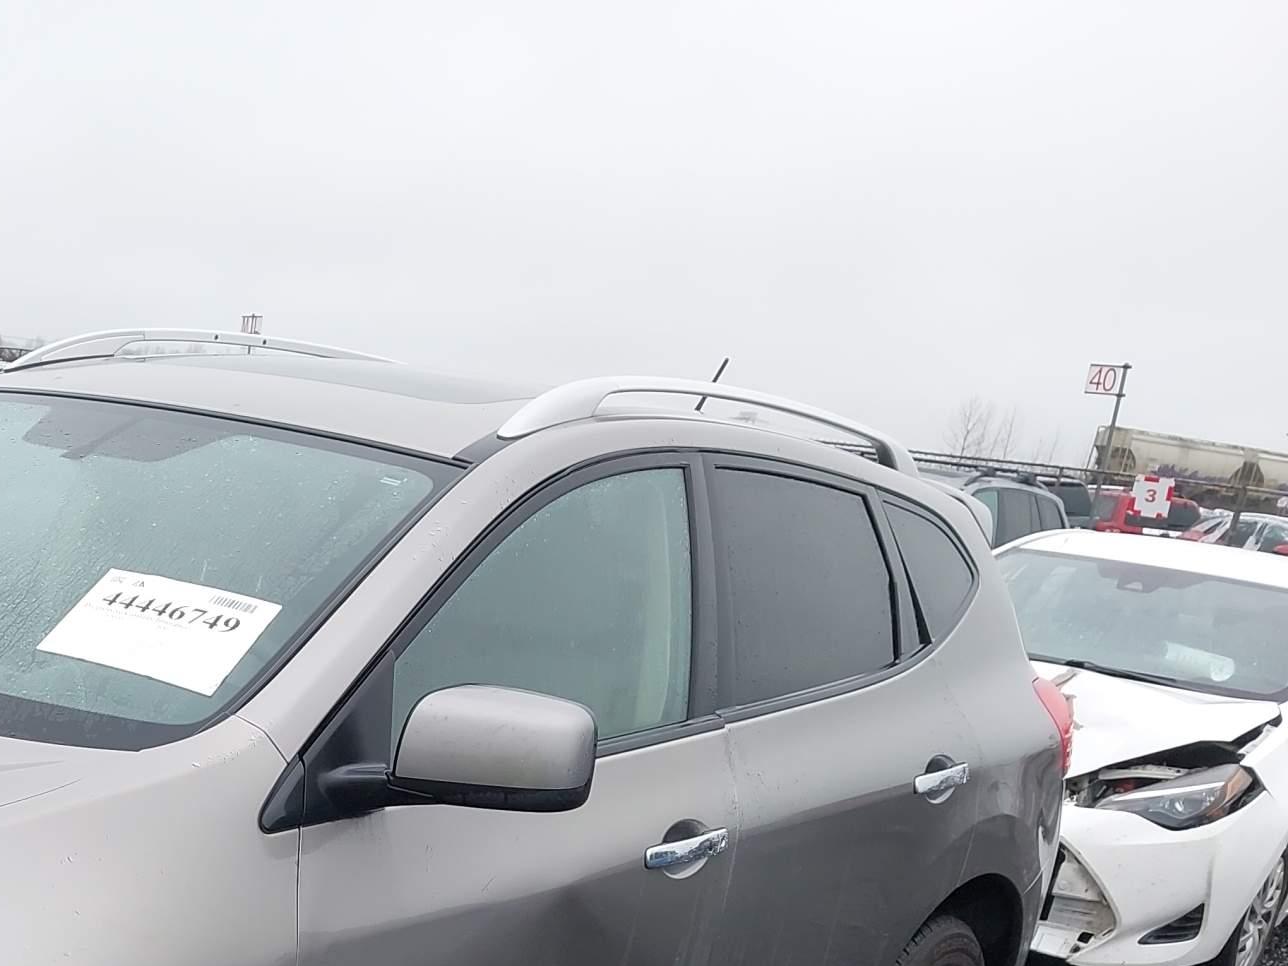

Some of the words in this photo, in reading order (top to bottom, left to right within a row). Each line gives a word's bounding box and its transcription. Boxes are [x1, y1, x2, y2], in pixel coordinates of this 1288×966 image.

[1088, 367, 1117, 392] 40
[1144, 488, 1157, 503] 3
[102, 592, 241, 632] 44446749
